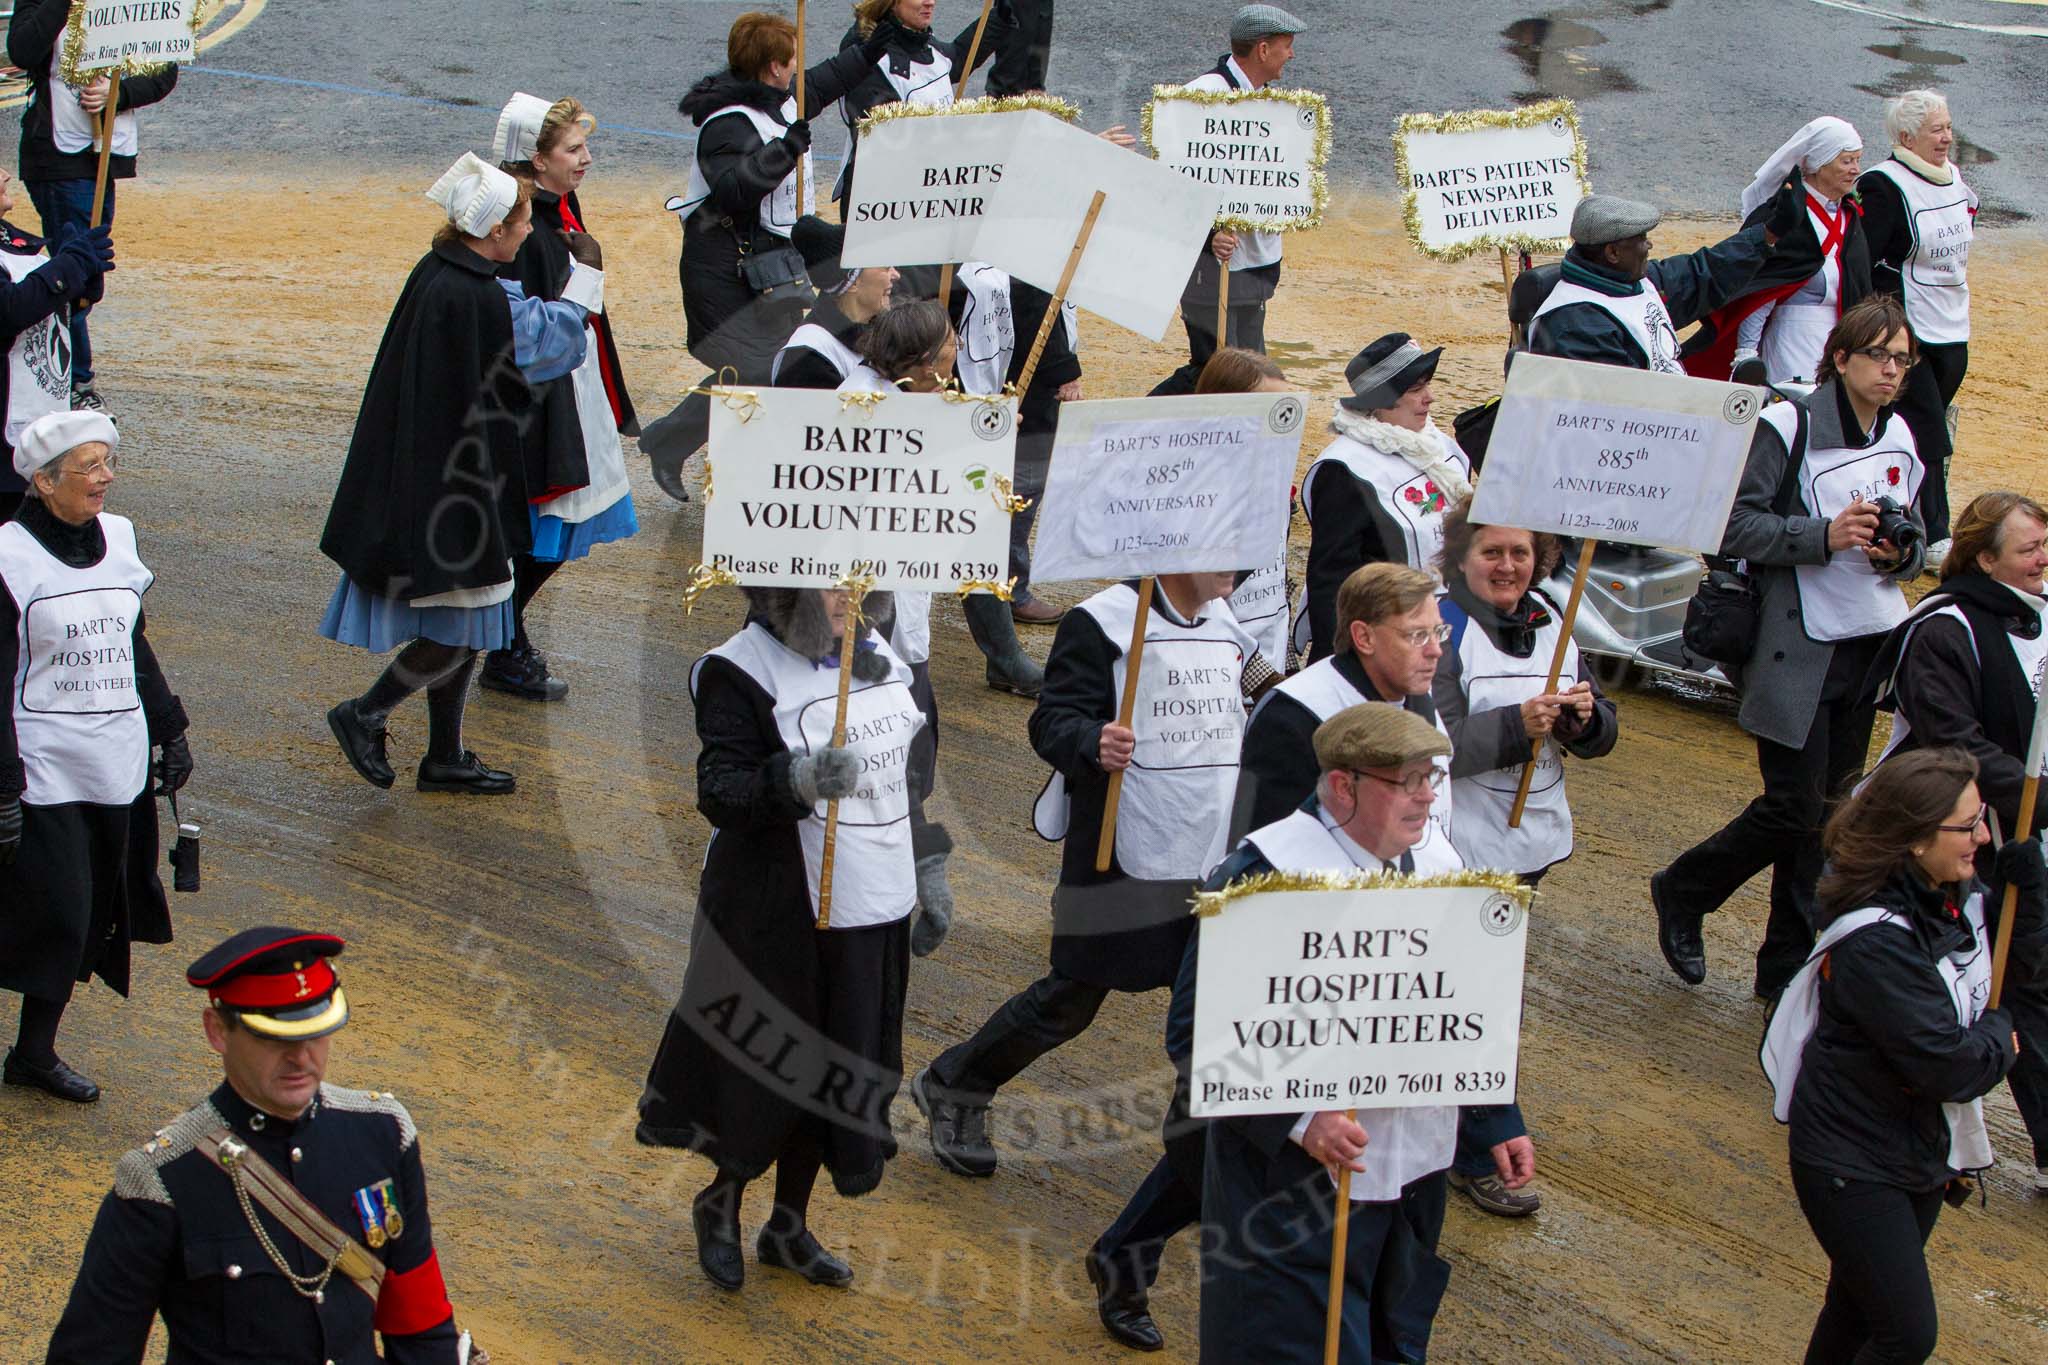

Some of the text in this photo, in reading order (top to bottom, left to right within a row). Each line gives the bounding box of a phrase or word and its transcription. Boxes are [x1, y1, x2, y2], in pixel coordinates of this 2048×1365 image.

[87, 1, 181, 28] VOLUNTEERS
[100, 45, 119, 60] Ring
[122, 42, 138, 57] 020
[142, 40, 161, 55] 7601
[166, 39, 190, 53] 8339
[1204, 118, 1271, 138] BART'S
[1187, 141, 1285, 163] HOSPITAL
[922, 163, 1004, 187] BART'S
[1169, 165, 1300, 189] OLUNTEERS
[1413, 157, 1571, 189] BART'S PATIENTS
[1441, 181, 1554, 208] NEWSPAPER
[855, 197, 984, 222] SOUVENIR
[1228, 202, 1249, 215] 020
[1254, 203, 1278, 216] 7601
[1284, 205, 1312, 217] 8339
[1445, 202, 1558, 230] DELIVERIES
[804, 425, 924, 455] BART'S
[1556, 413, 1700, 442] BART'S HOSPITAL
[1104, 430, 1244, 453] BART'S HOSPITAL
[1145, 457, 1195, 486] 885th
[1597, 447, 1649, 470] 885th
[772, 464, 950, 495] HOSPITAL
[1553, 476, 1671, 500] ANNIVERSARY
[1103, 493, 1218, 515] ANNIVERSARY
[740, 501, 977, 535] VOLUNTEERS
[712, 554, 999, 581] Please Ring 020 7601 8339
[66, 616, 126, 640] BART'S
[50, 646, 135, 668] HOSPITAL
[1167, 667, 1231, 686] BART'S
[1153, 697, 1240, 717] HOSPITAL
[846, 710, 911, 744] BART'S
[1300, 928, 1429, 960] BART'S
[1265, 970, 1456, 1004] HOSPITAL
[1232, 1012, 1484, 1049] VOLUNTEERS
[1202, 1071, 1506, 1103] Please Ring 020 7601 8339
